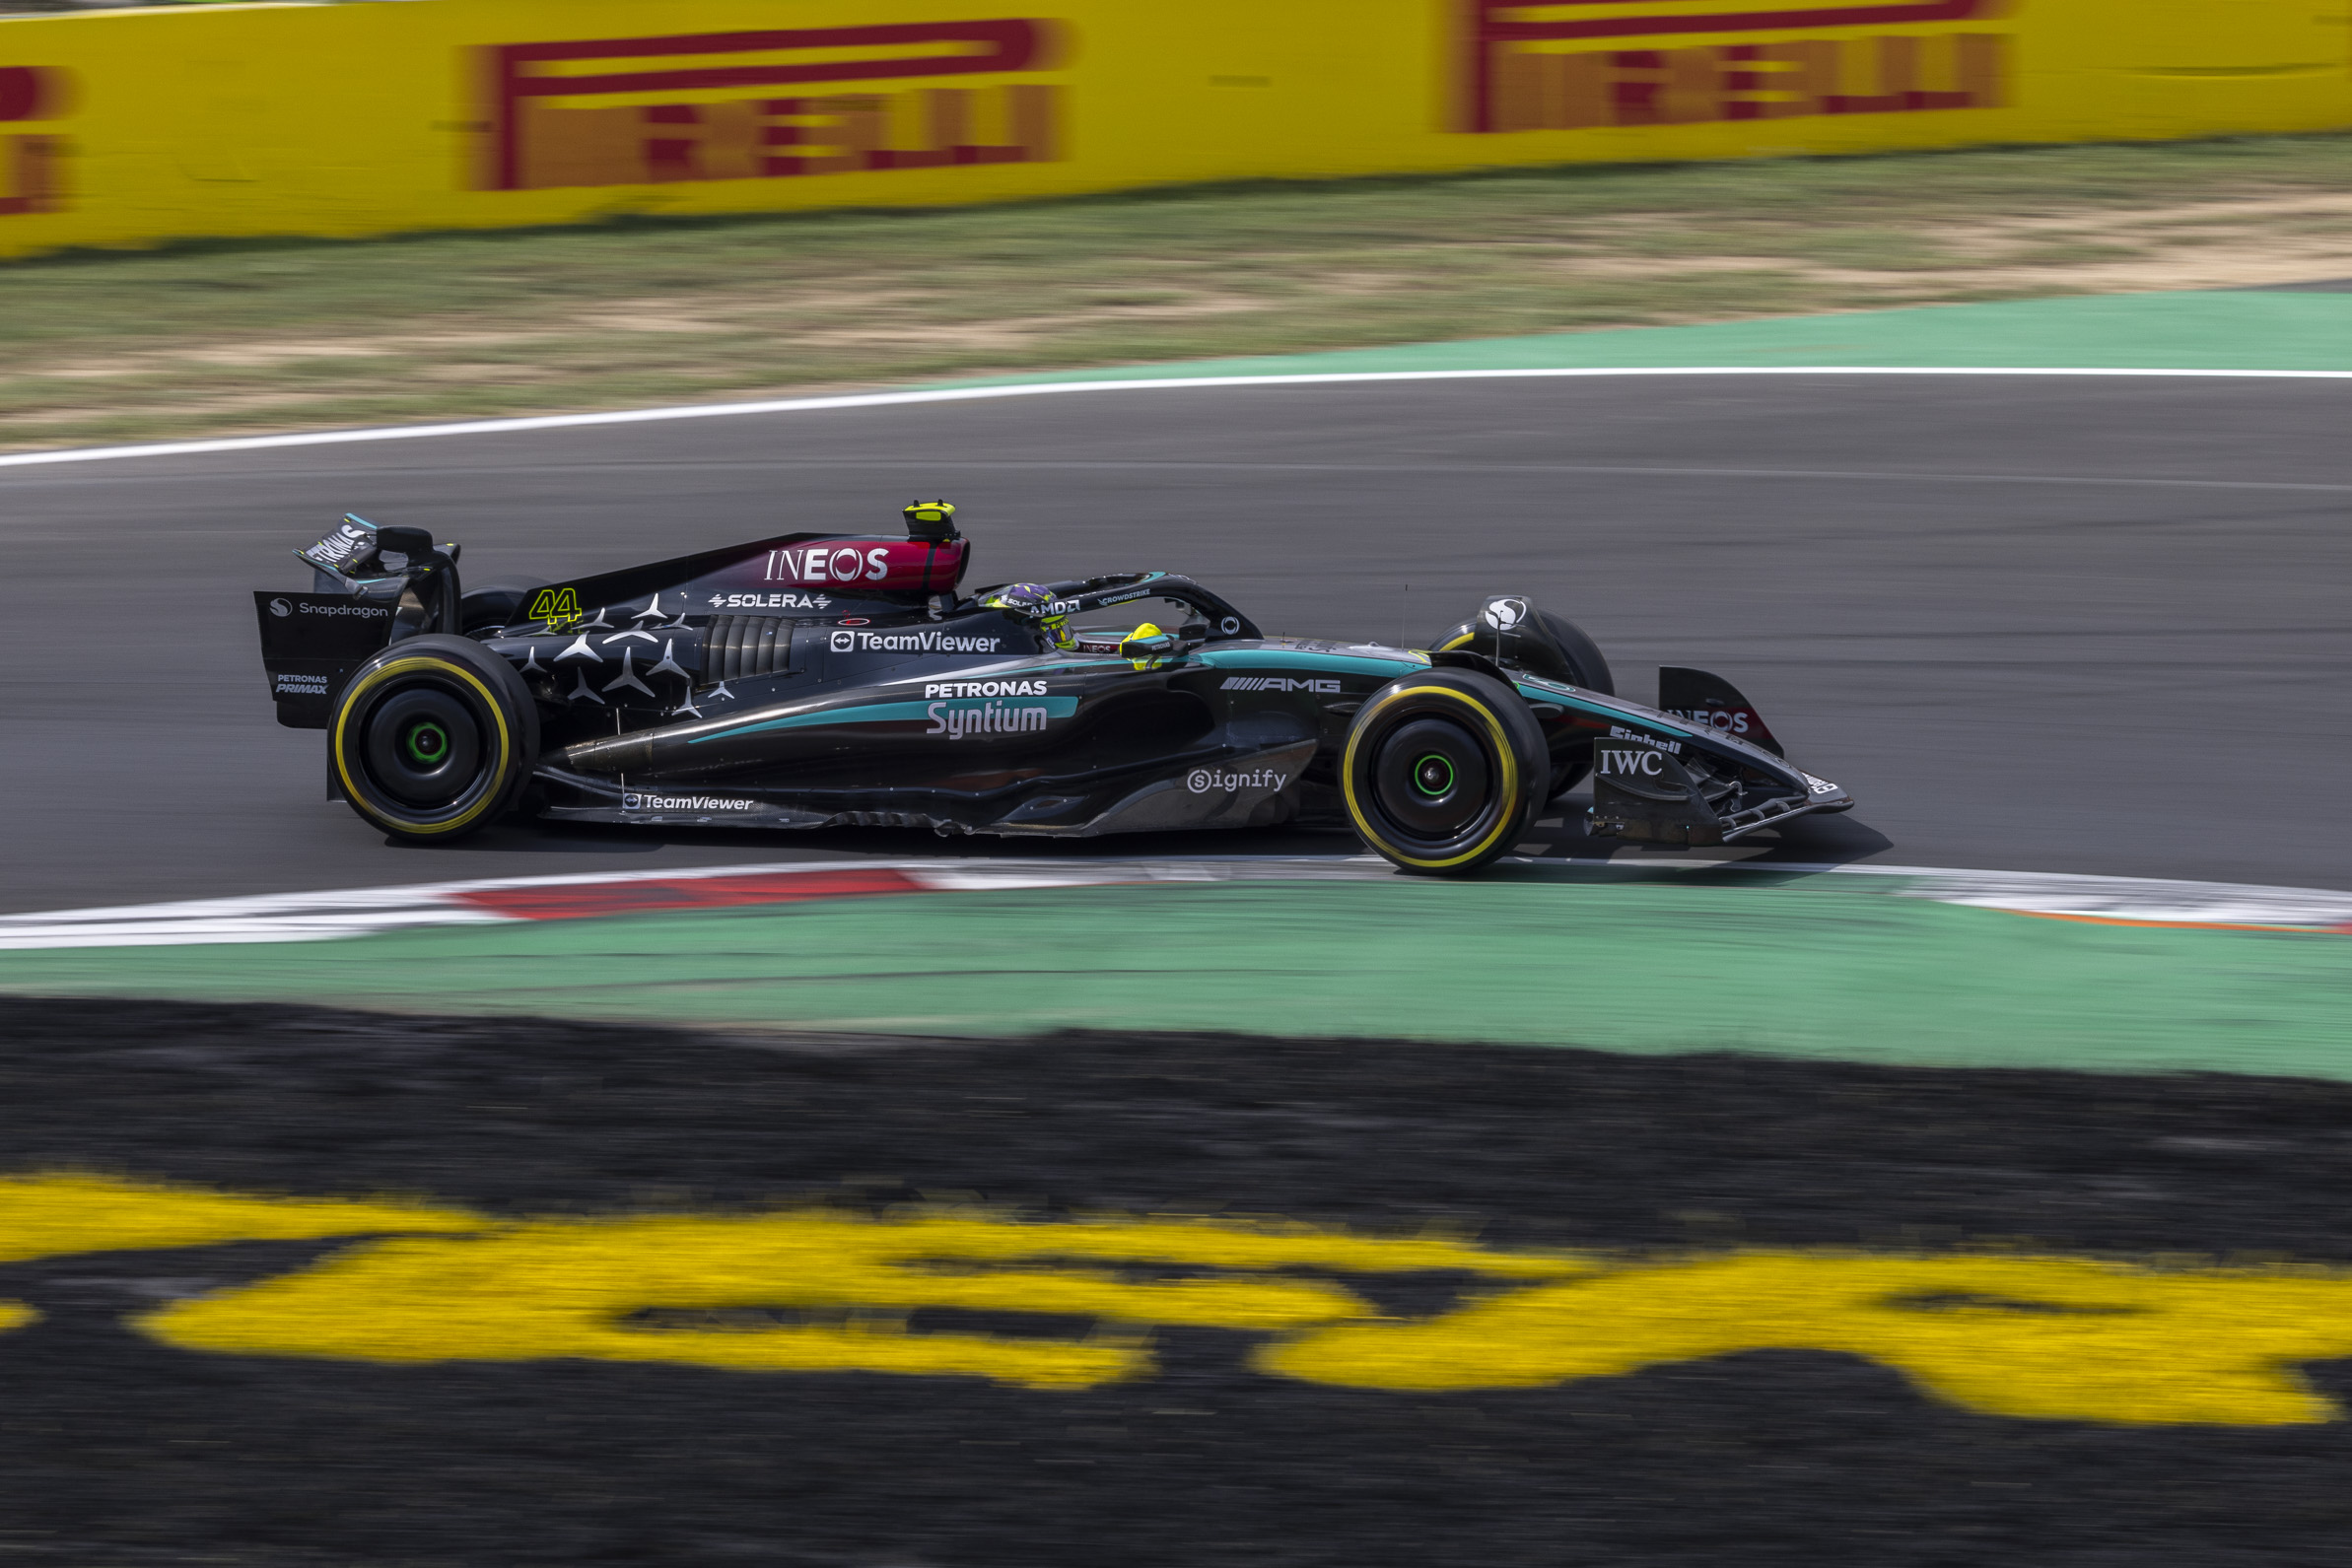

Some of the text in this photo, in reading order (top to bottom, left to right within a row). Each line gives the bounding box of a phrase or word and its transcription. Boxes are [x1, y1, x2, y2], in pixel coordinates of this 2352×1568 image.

[764, 548, 889, 581] INEOS
[726, 593, 814, 609] SOLERA
[1102, 588, 1151, 604] CROWDSTRIKE
[299, 602, 389, 619] Snapdragon
[528, 587, 583, 625] 44
[1030, 599, 1066, 616] AMD
[857, 632, 1001, 652] TeamViewer
[1084, 645, 1112, 653] INEOS
[277, 674, 327, 684] PETRONAS
[1257, 677, 1342, 693] AMG
[276, 684, 330, 695] PRIMAX
[925, 680, 1048, 699] PETRONAS
[926, 700, 1048, 740] Syntium
[1600, 750, 1663, 776] IWC
[644, 794, 753, 810] TeamViewer
